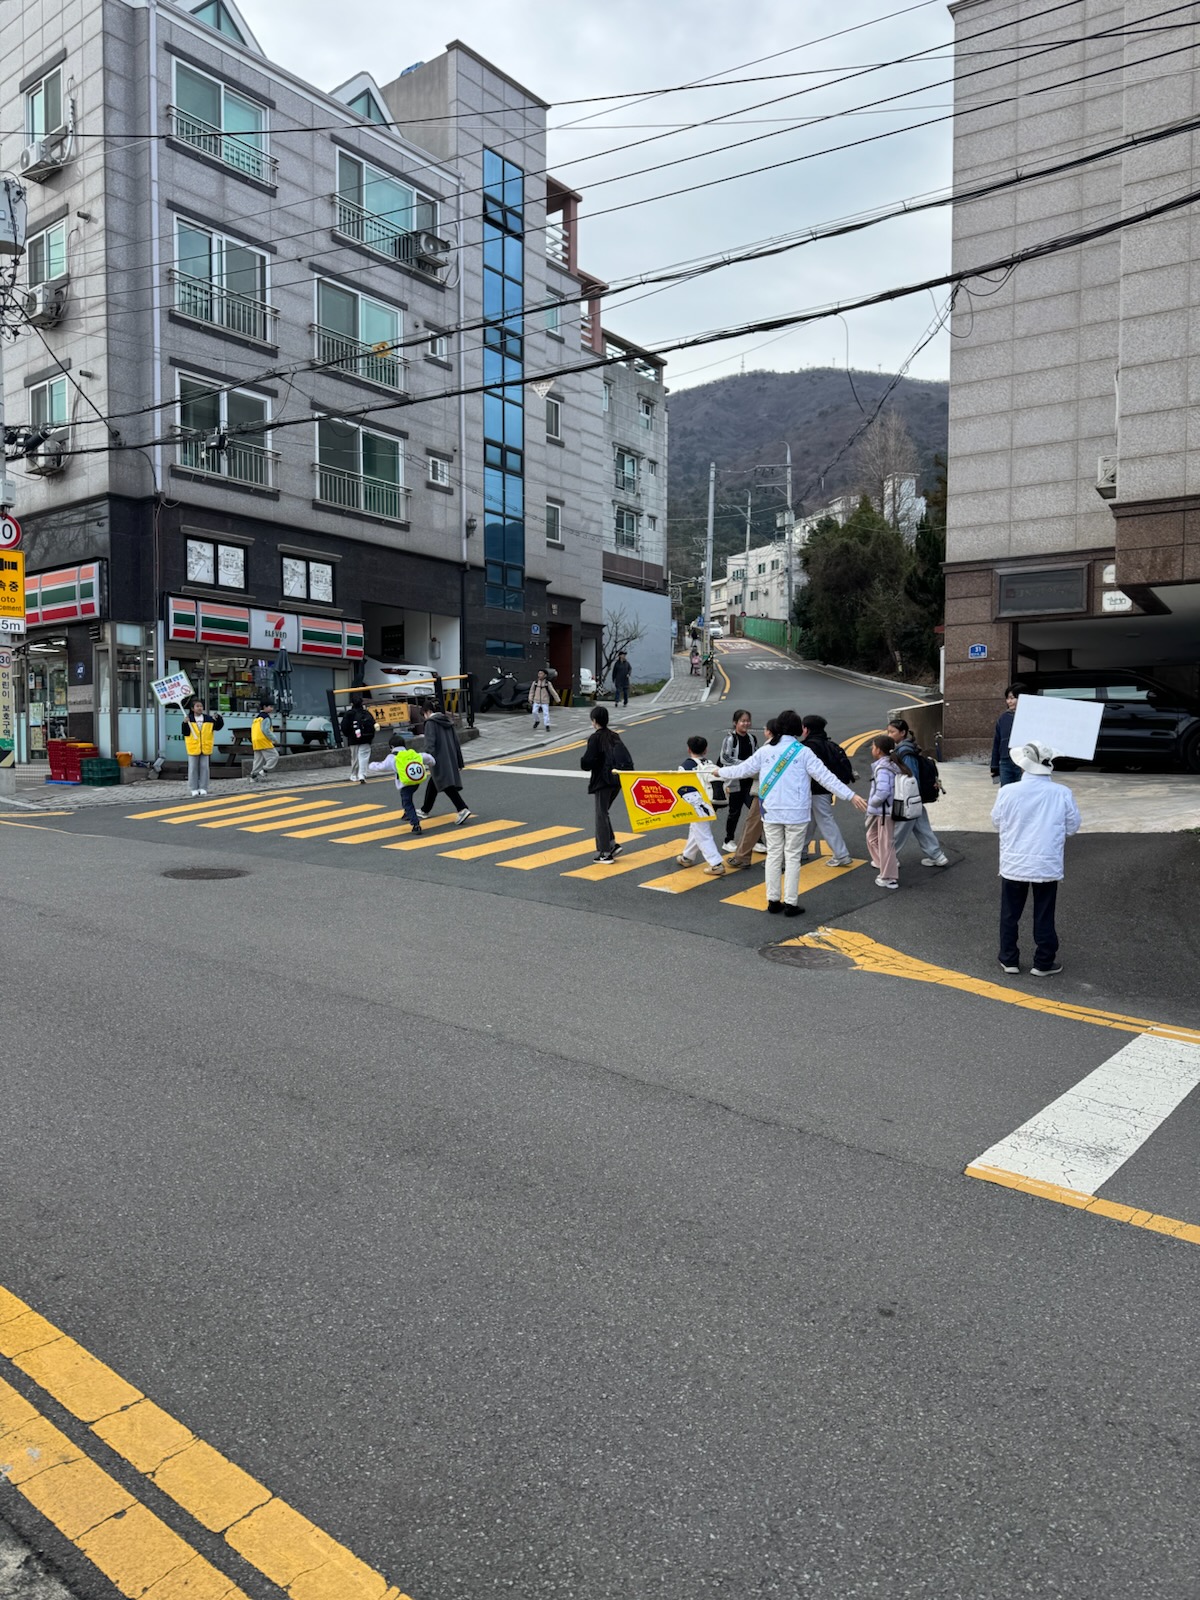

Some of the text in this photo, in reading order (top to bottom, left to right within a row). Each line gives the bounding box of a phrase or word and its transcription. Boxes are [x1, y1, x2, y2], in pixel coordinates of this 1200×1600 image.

[1, 671, 10, 699] 어린이
[2, 705, 11, 740] 보호구역
[409, 766, 422, 776] 30
[641, 785, 662, 794] 잠깐!
